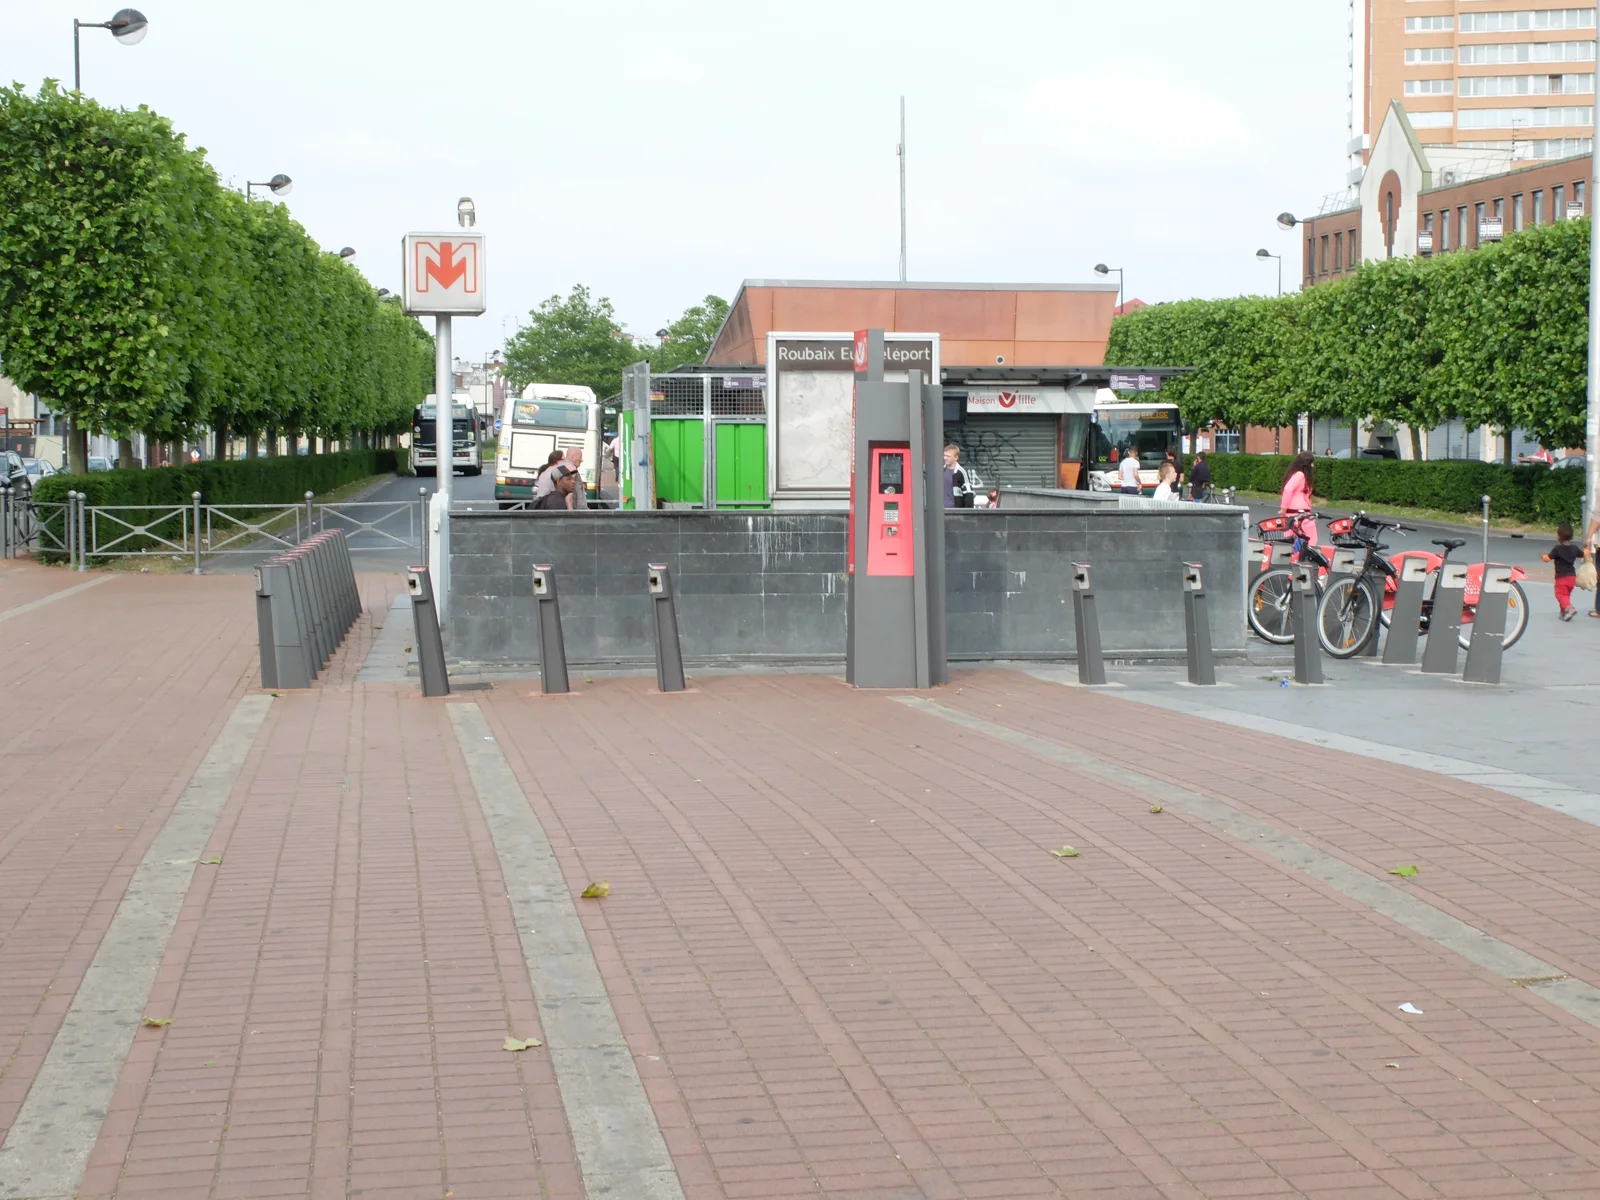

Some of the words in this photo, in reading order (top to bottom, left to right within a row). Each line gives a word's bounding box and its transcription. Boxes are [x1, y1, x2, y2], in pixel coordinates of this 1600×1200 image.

[778, 346, 835, 361] Roubaix
[840, 346, 931, 363] Eléport
[968, 396, 996, 405] Maison
